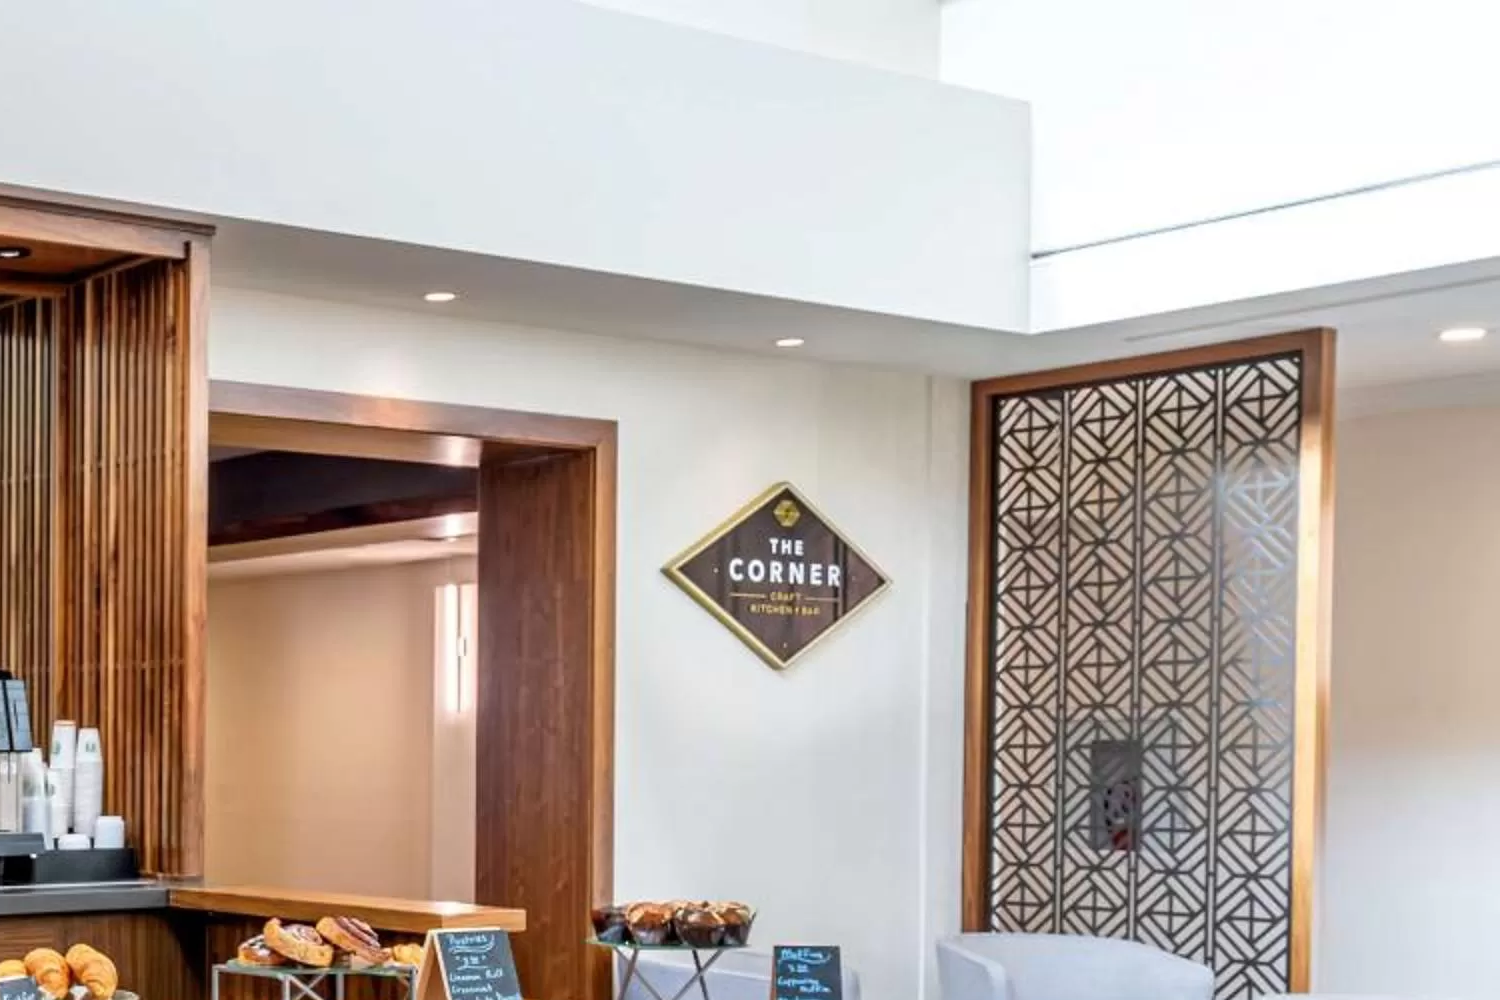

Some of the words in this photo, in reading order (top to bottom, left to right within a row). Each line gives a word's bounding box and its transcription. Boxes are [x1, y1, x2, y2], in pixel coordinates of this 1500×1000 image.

[769, 538, 804, 556] THE
[729, 558, 841, 587] CORNER
[769, 591, 801, 603] CRAFT
[749, 605, 793, 616] KITCHEN
